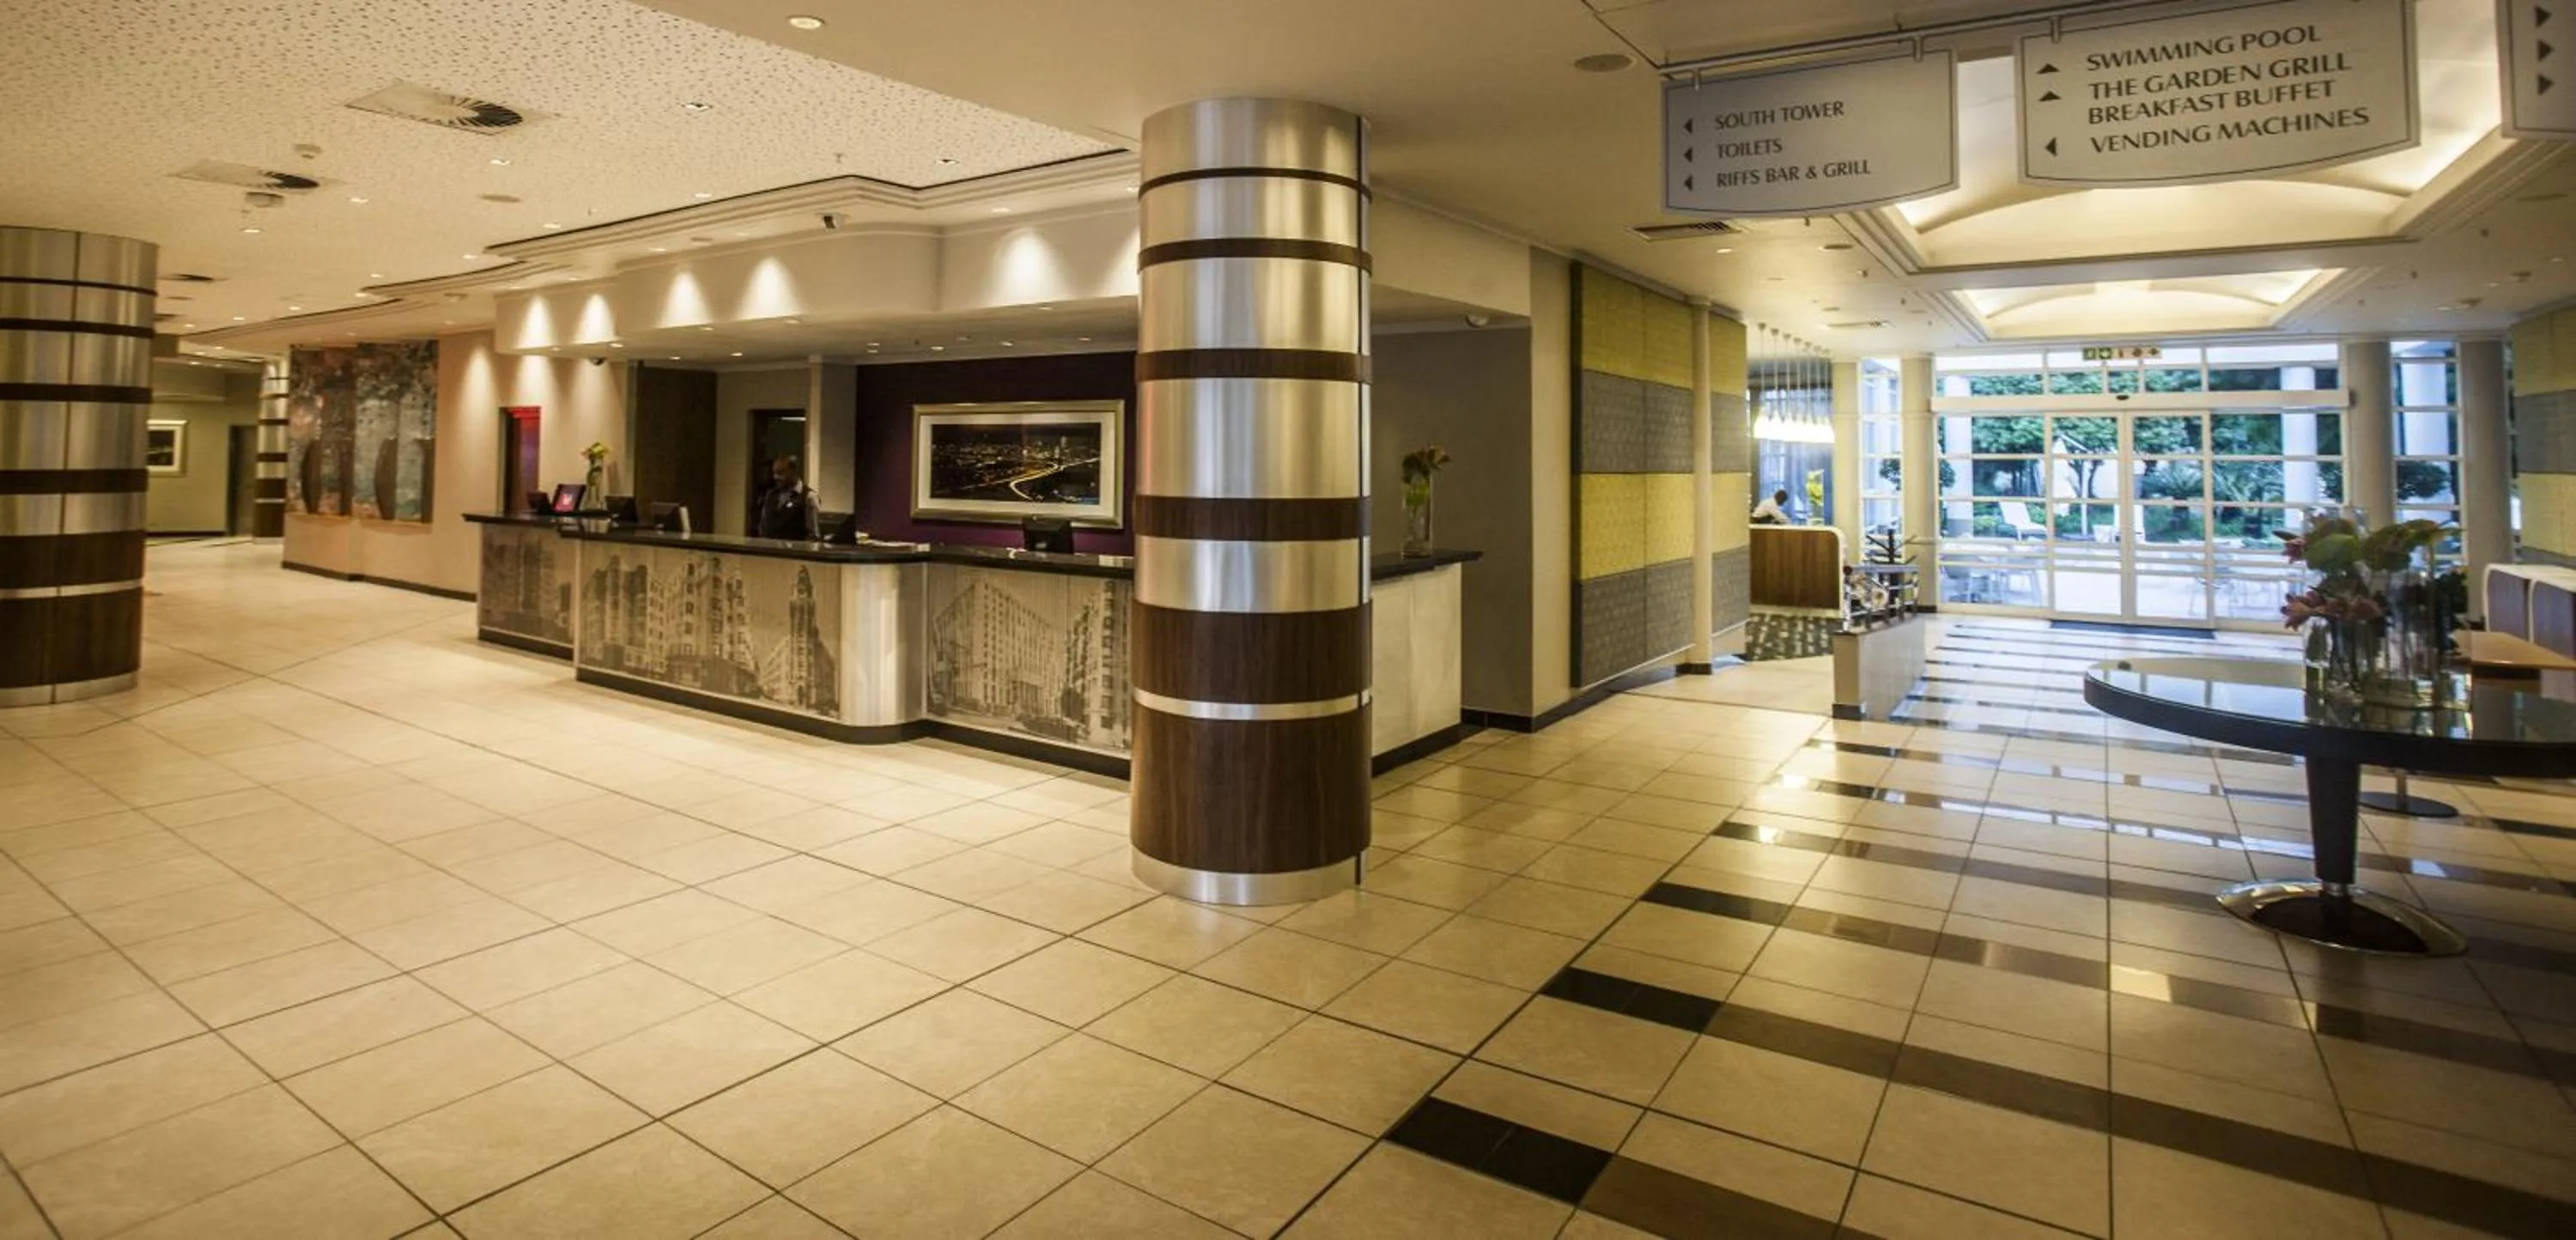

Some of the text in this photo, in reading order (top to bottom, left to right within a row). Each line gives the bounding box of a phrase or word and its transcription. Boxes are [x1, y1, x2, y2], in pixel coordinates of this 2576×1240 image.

[2087, 25, 2322, 70] SWIMMING POOL
[2088, 52, 2353, 100] THE GARDEN GRILL
[1715, 100, 1844, 130] SOUTH TOWER
[2088, 79, 2336, 125] BREAKFAST BUFFET
[1718, 138, 1783, 159] TOILETS
[2090, 107, 2370, 154] VENDING MACHINES
[1717, 160, 1872, 188] RIFFS BAR & GRILL
